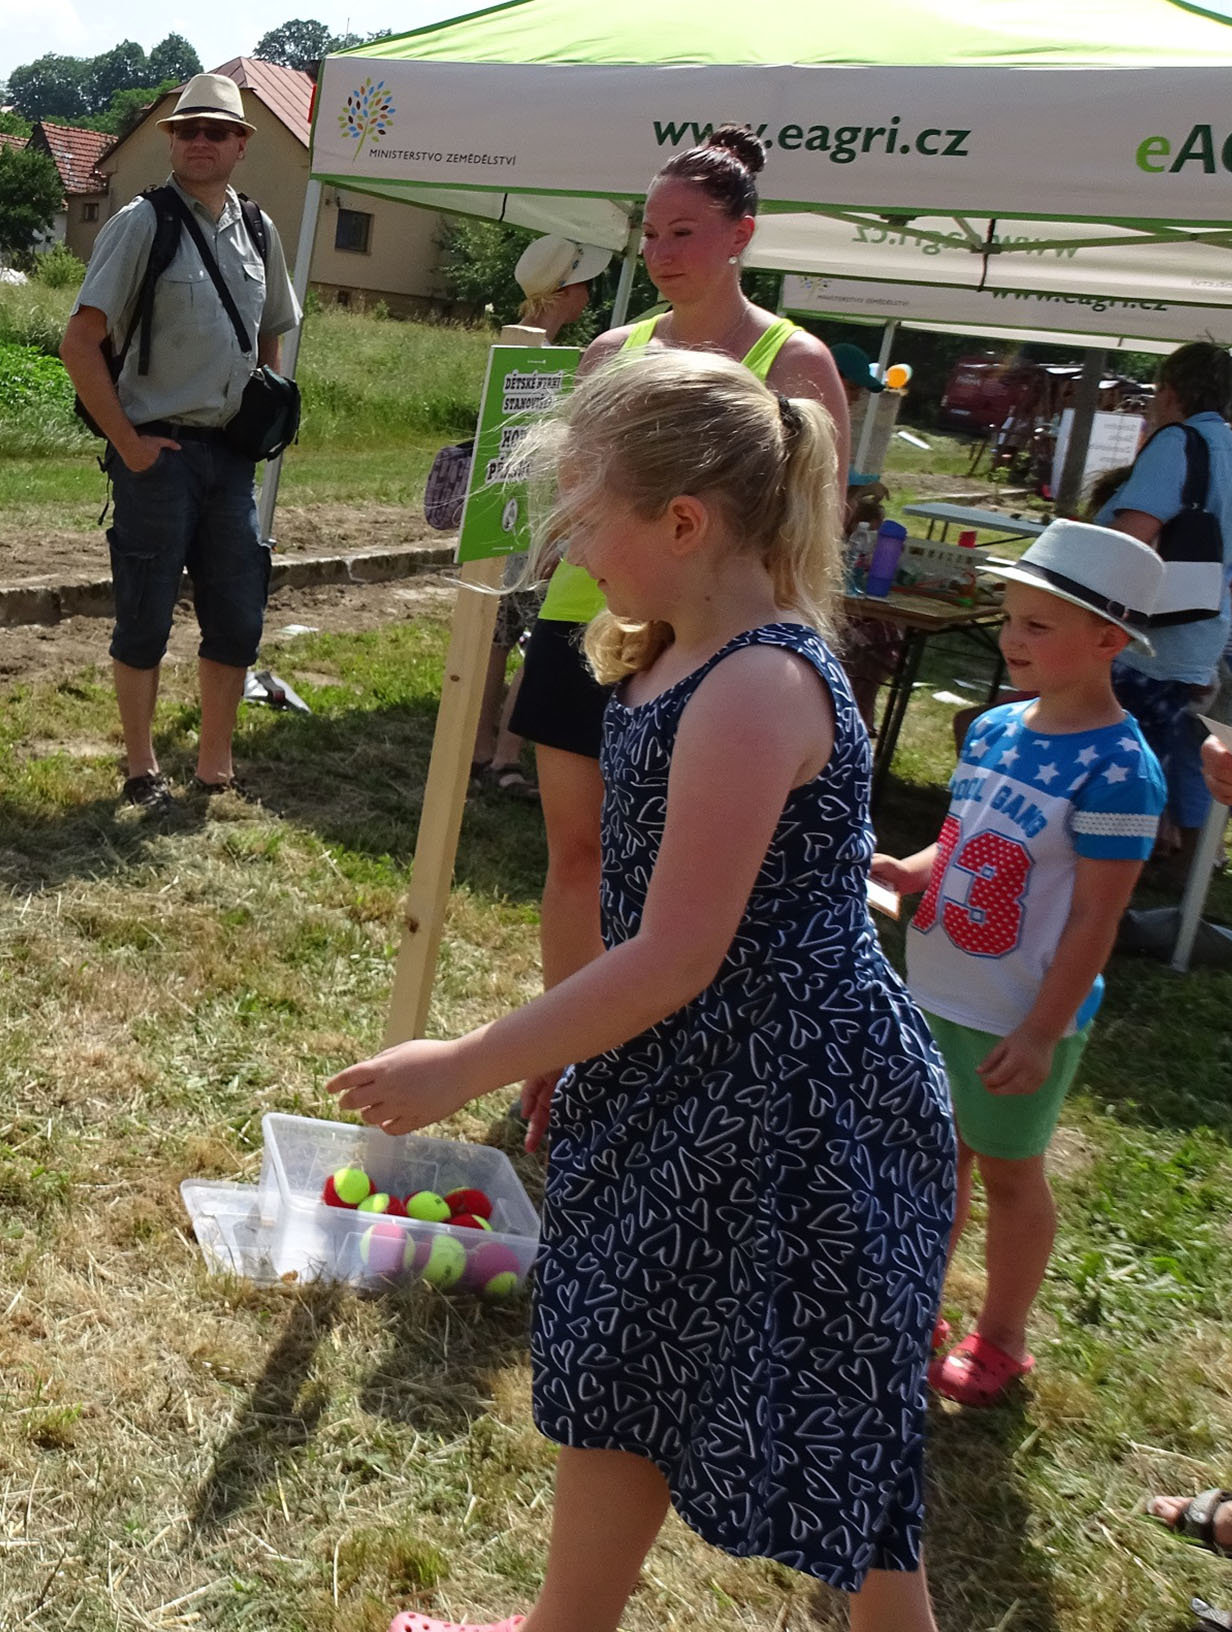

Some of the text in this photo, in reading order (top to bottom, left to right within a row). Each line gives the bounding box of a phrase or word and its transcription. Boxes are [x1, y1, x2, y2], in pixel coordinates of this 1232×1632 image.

[369, 149, 443, 162] MINISTERSTVO
[654, 115, 971, 164] ww.eagri.cz
[1136, 124, 1232, 173] eA
[950, 777, 1048, 839] OOL GANG
[910, 811, 1036, 960] 13
